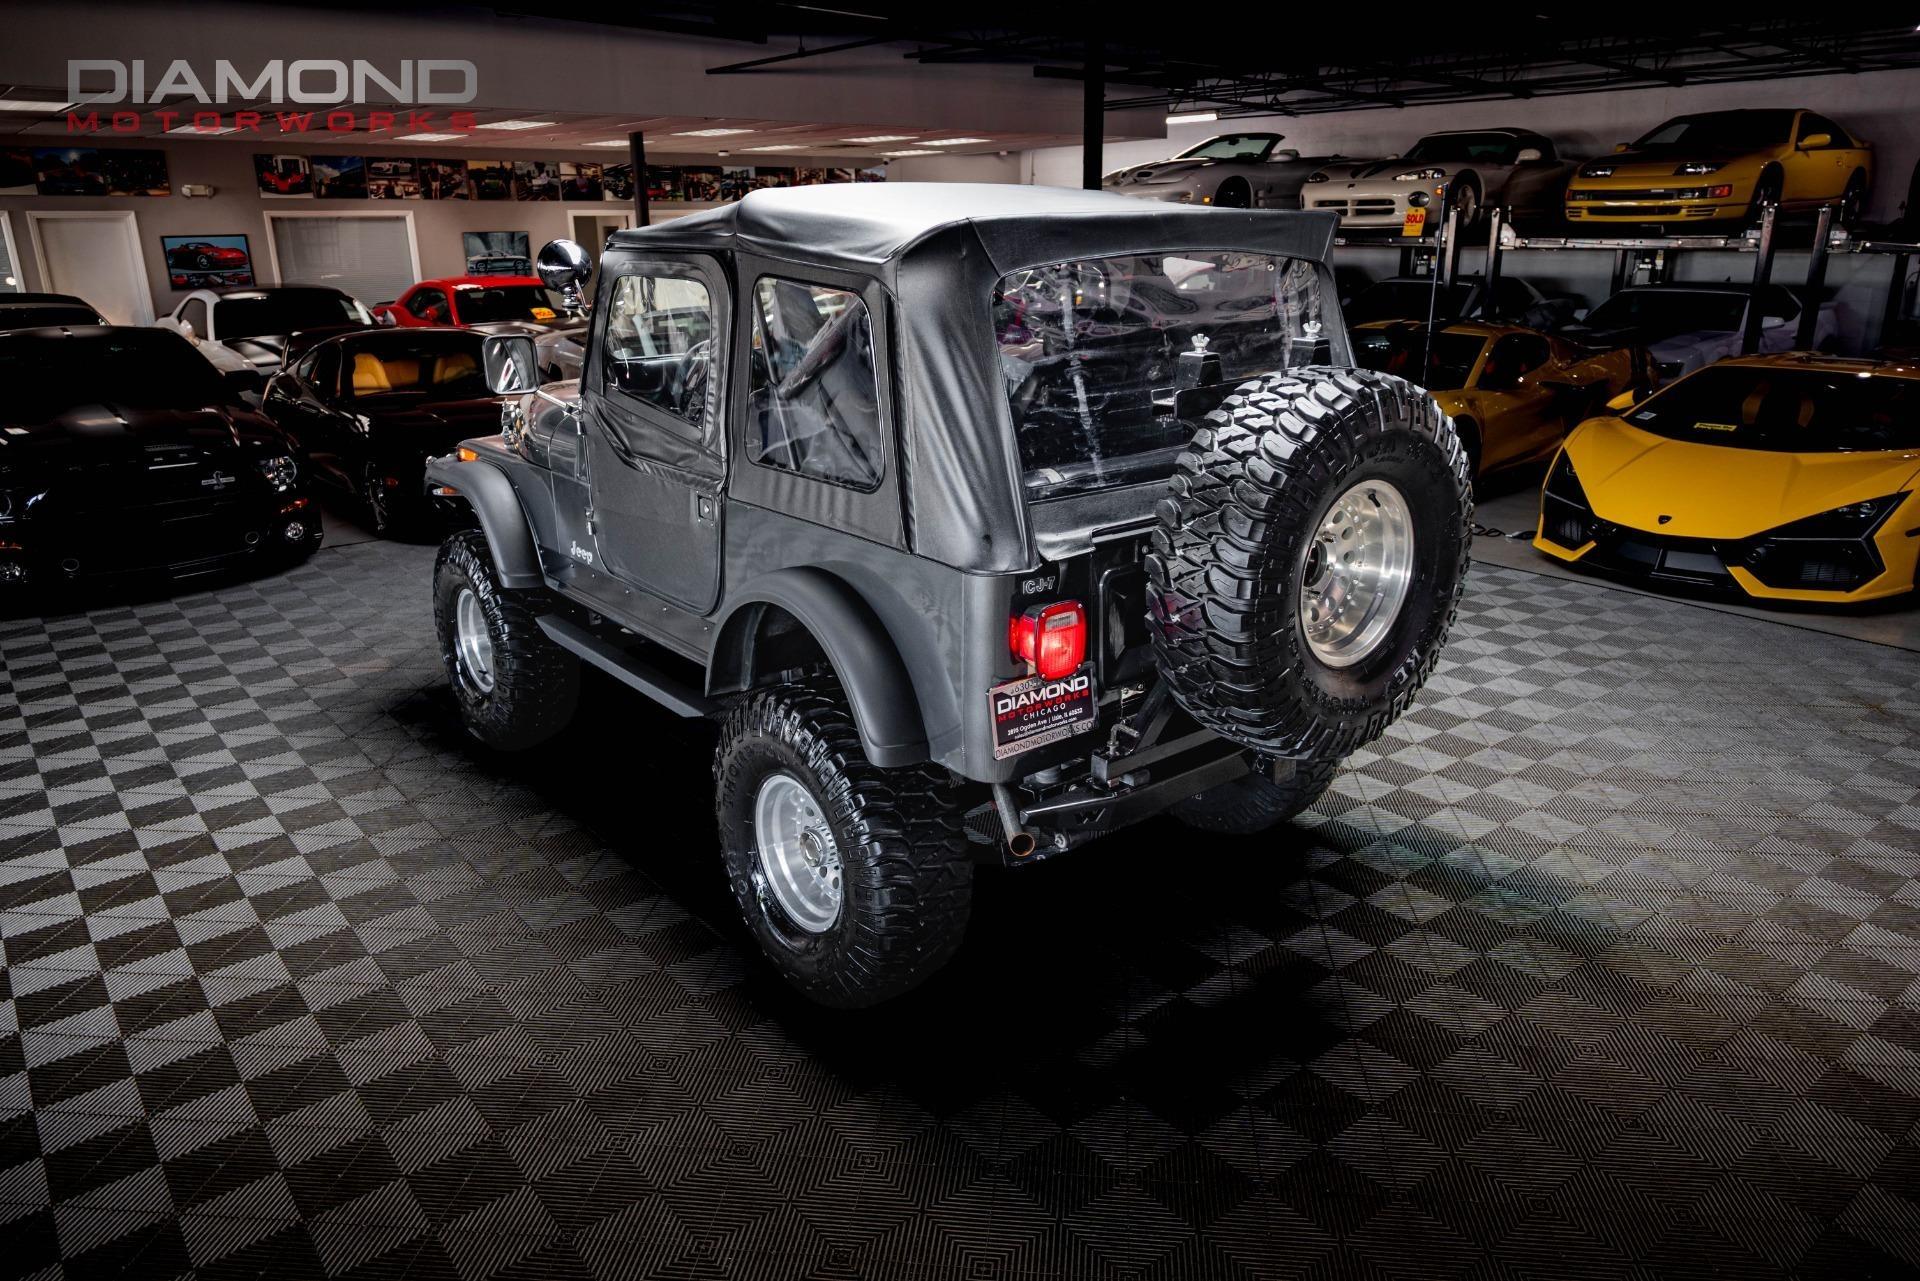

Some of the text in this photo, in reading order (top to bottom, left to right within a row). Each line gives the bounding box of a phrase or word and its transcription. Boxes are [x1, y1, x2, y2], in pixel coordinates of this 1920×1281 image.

[1405, 214, 1424, 224] SOLD
[570, 540, 593, 565] Jeep
[1024, 576, 1055, 594] CJ-7
[997, 676, 1089, 715] DIAMOND
[998, 689, 1089, 722] MOTORWORKS
[1023, 703, 1066, 721] CHICAGO
[1019, 722, 1037, 731] Ogden
[995, 720, 1095, 759] DIAMONDMOTORWORKS.CO
